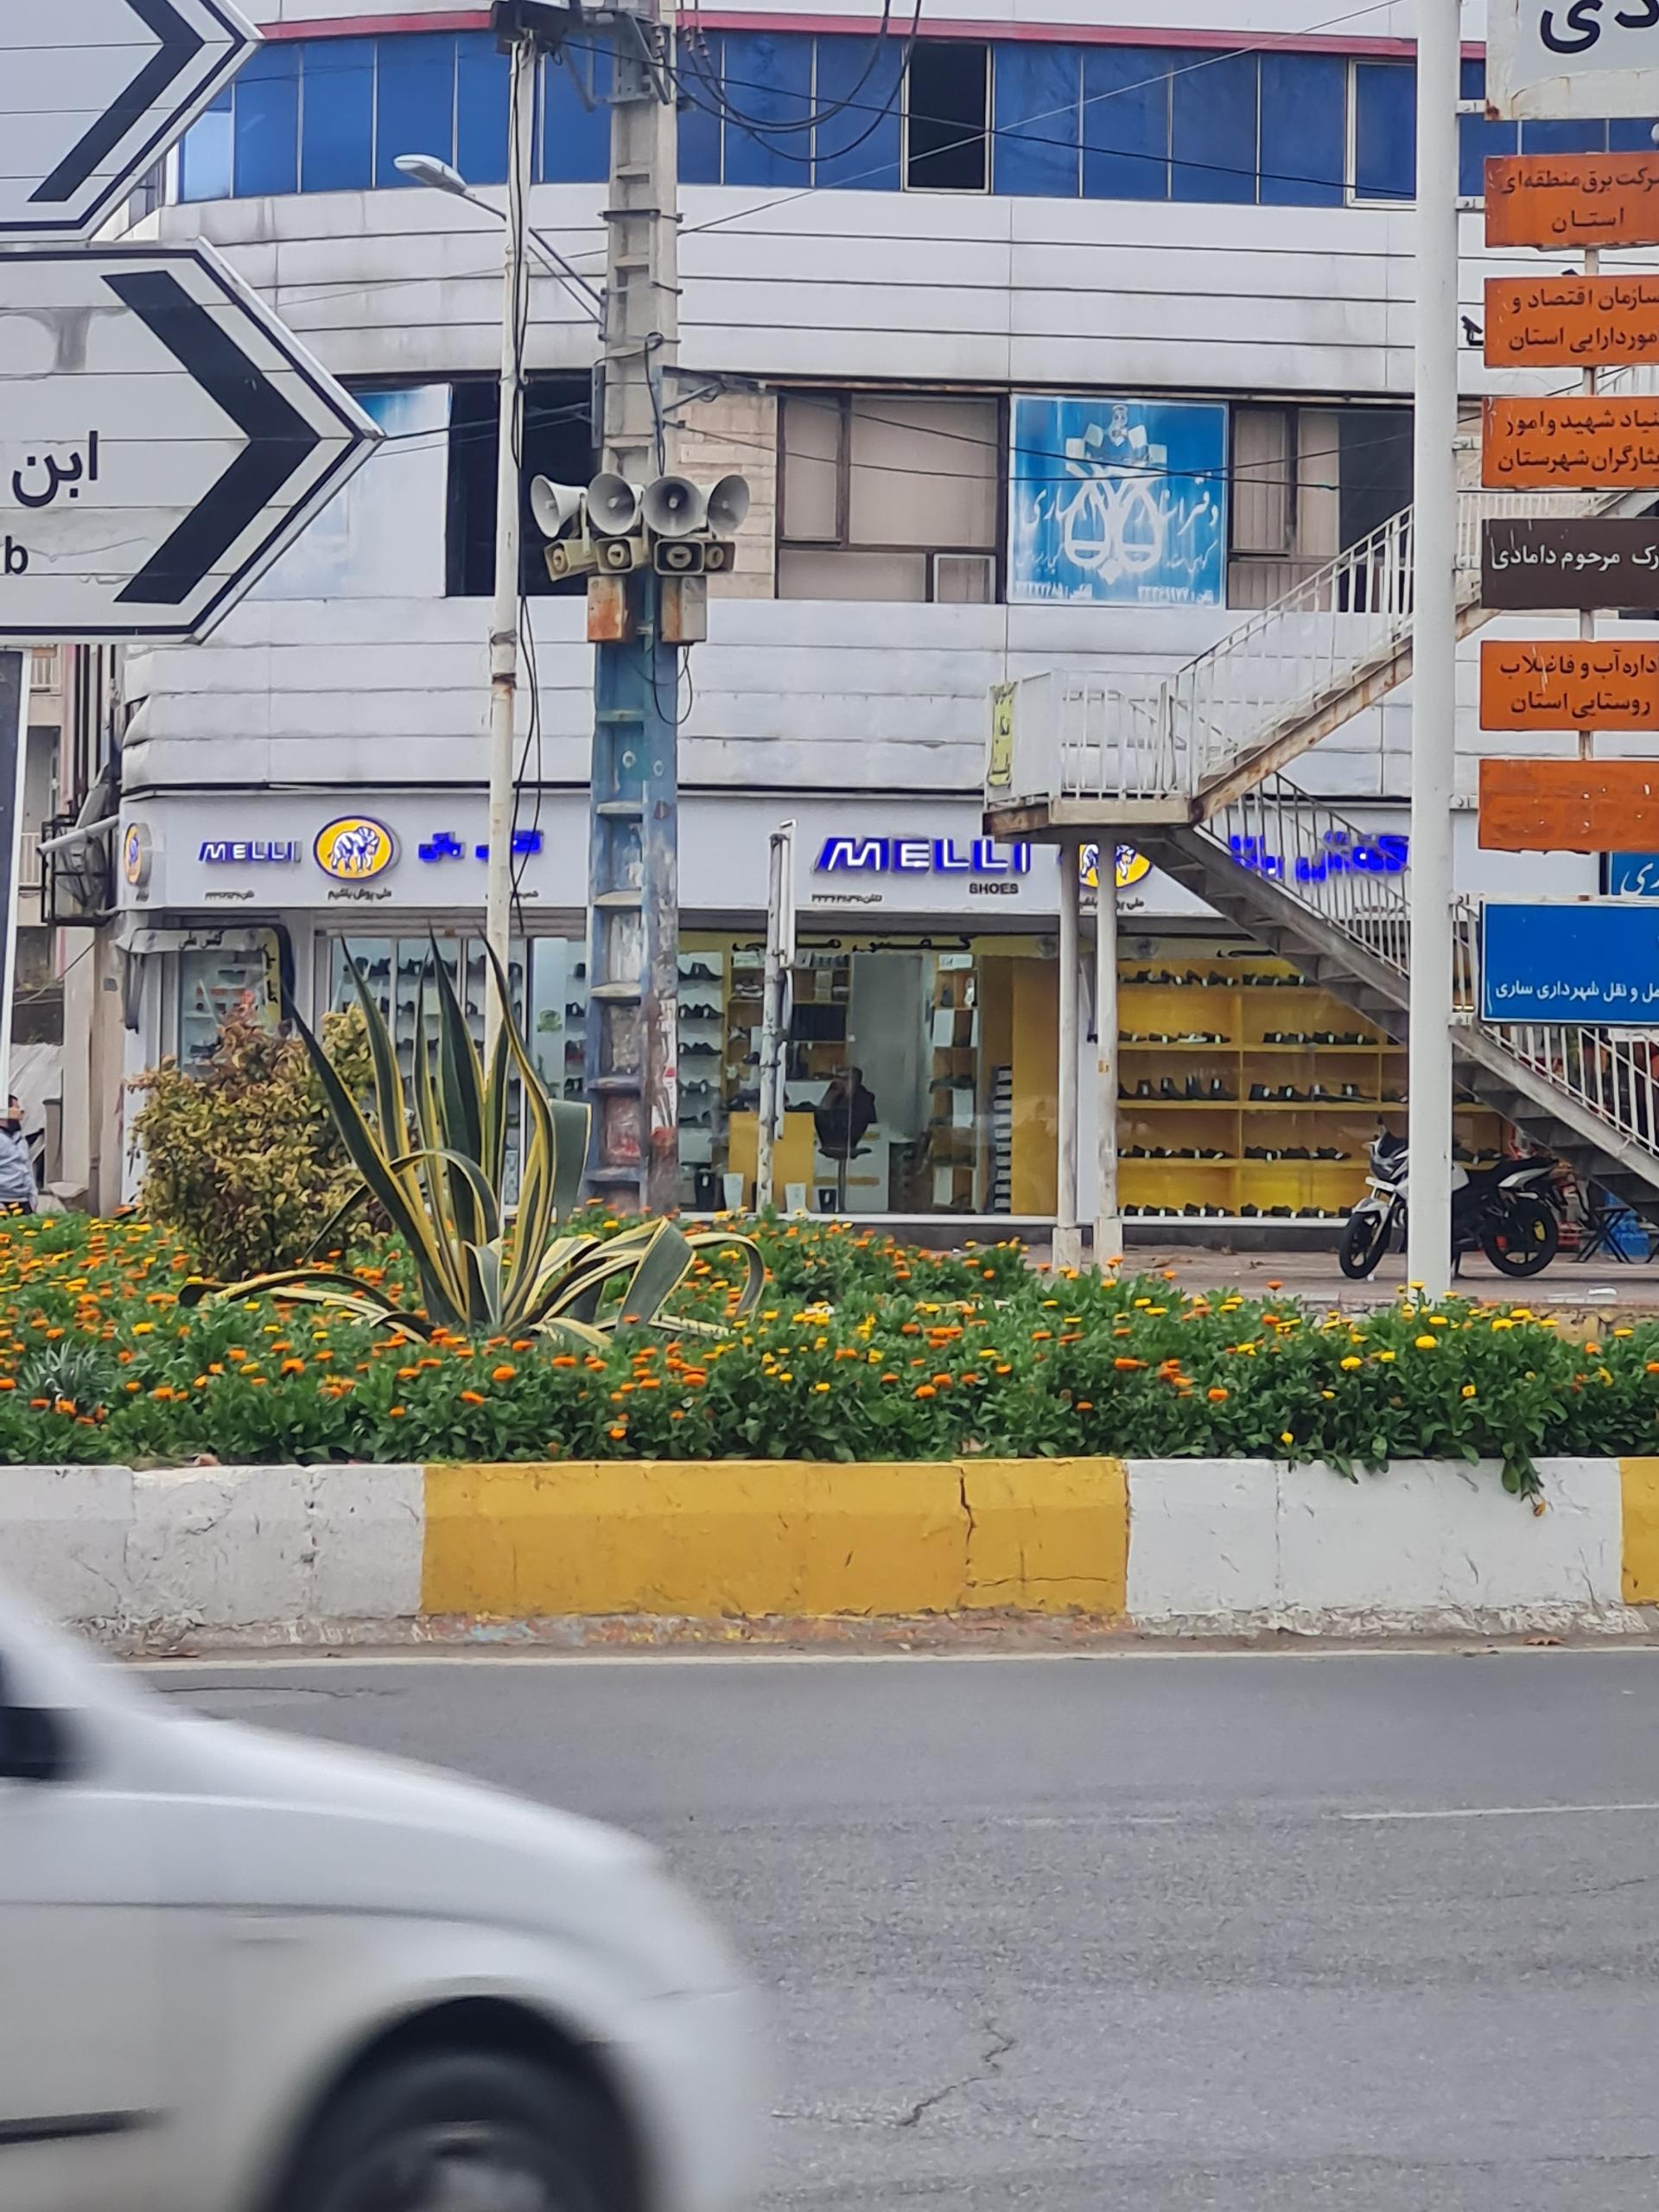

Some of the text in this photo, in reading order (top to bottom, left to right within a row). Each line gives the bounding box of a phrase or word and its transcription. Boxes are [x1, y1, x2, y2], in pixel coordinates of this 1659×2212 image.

[1581, 170, 1612, 194] برق
[1616, 167, 1659, 193] رکت
[1551, 207, 1624, 233] استان
[1512, 294, 1522, 314] و
[1528, 288, 1592, 308] اقتصاد
[1509, 327, 1564, 350] استان
[1560, 409, 1615, 435] شهید
[12, 430, 98, 508] ابن
[1497, 448, 1589, 474] شهرستان
[1491, 543, 1557, 570] دامادی
[1561, 553, 1620, 571] مرحوم
[1580, 662, 1590, 679] و
[1592, 649, 1622, 680] آب
[1623, 653, 1659, 678] داره
[1510, 691, 1651, 719] روستایی استان
[198, 841, 295, 863] MELLI
[813, 836, 1032, 874] MELLI
[969, 882, 1019, 895] SHOES
[1495, 979, 1534, 999] ساری
[1535, 979, 1600, 1001] شهرداری
[1603, 982, 1627, 1003] نقل
[1630, 986, 1639, 1003] و
